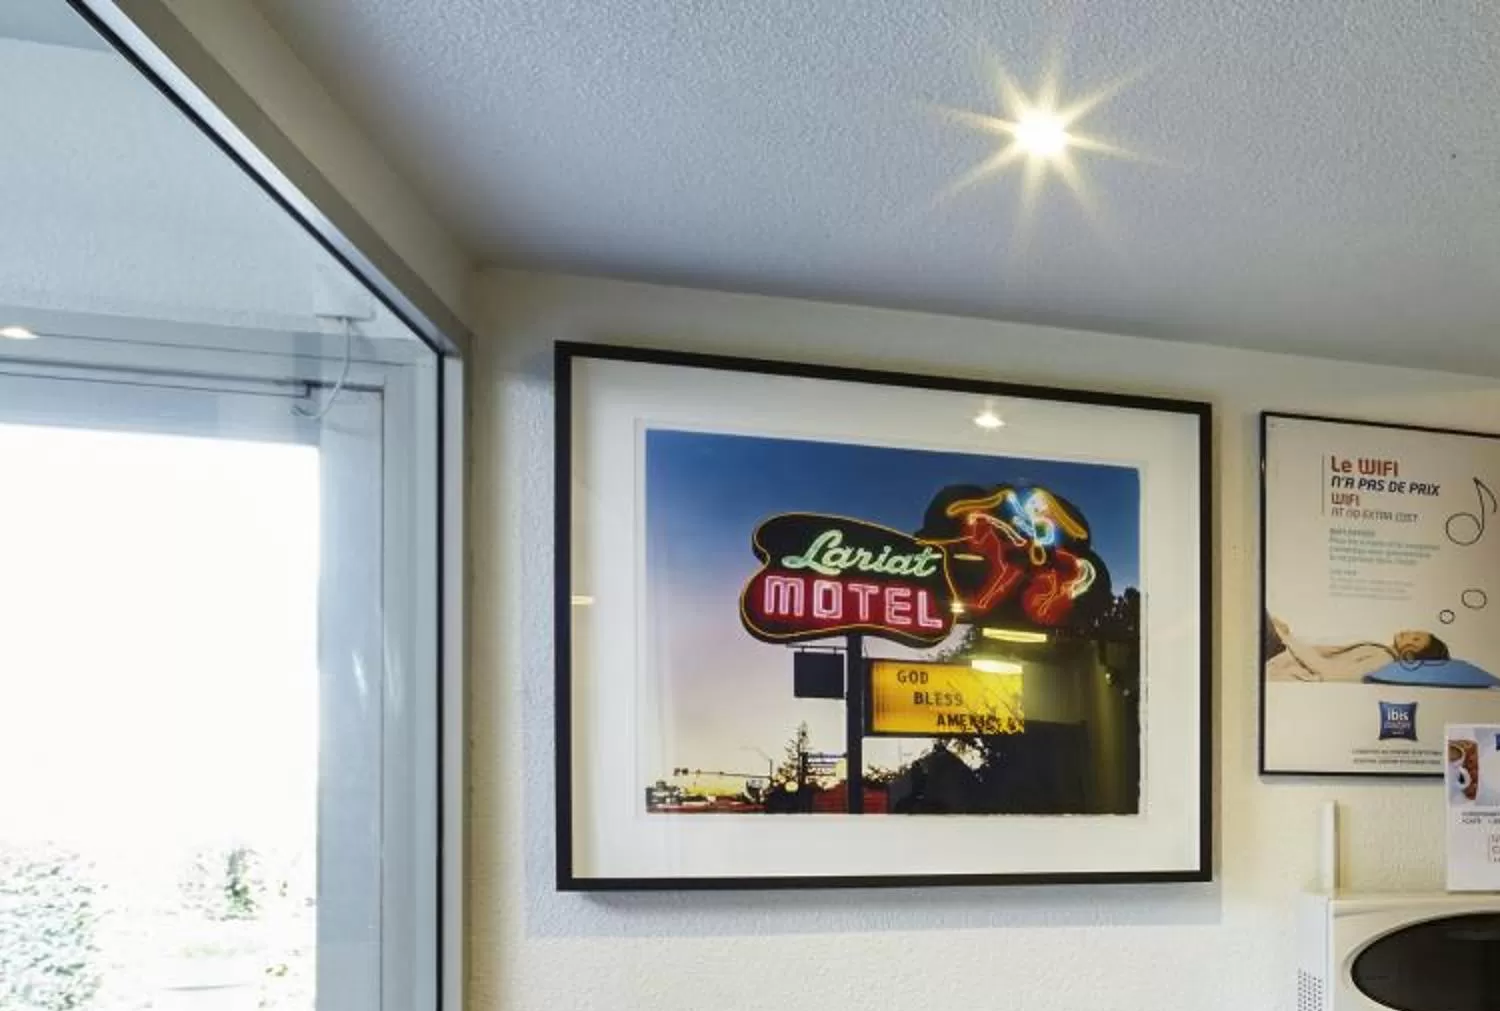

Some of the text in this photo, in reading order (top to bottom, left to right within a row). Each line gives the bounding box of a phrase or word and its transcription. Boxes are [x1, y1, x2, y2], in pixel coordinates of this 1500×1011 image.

[1331, 455, 1399, 477] Le WIFI
[1358, 478, 1385, 492] PAS
[1388, 481, 1407, 494] DE
[1409, 482, 1440, 497] PRIX
[1331, 492, 1360, 507] WIFI
[781, 529, 943, 577] Lariat
[763, 575, 943, 629] MOTEL
[897, 670, 929, 685] GOD
[913, 691, 964, 707] BLESS
